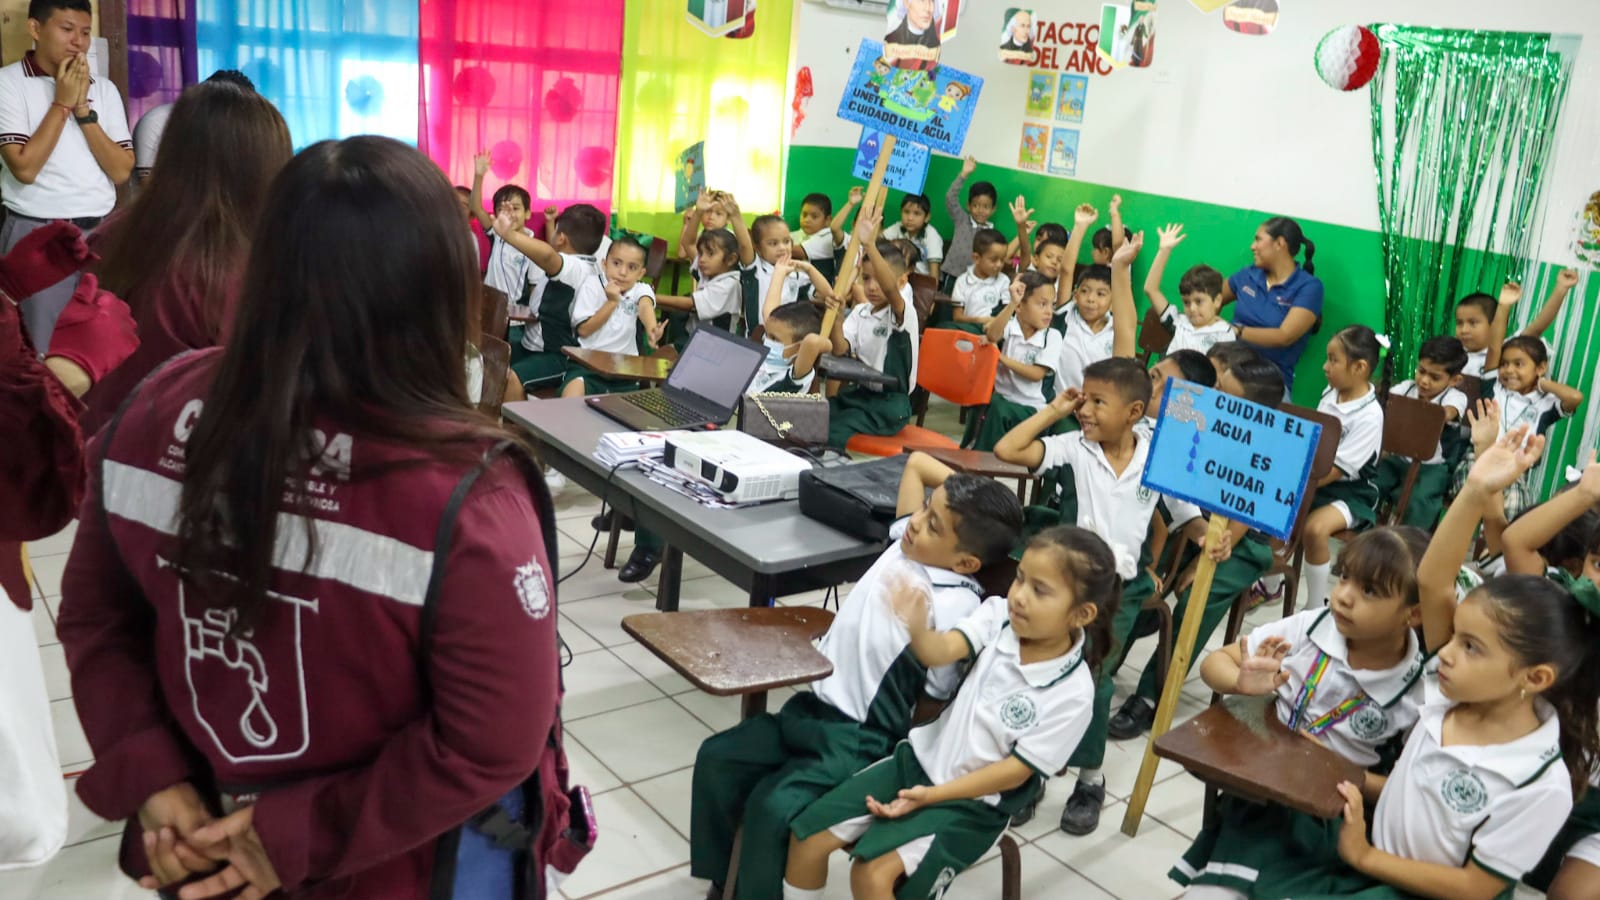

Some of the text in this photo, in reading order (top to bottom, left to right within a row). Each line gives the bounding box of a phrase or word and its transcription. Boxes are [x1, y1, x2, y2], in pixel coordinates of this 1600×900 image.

[848, 100, 951, 142] CUIDADO DEL AGUA
[853, 87, 944, 128] UNETE AL
[1211, 418, 1252, 446] AGUA
[1215, 394, 1305, 439] CUIDAR EL
[1250, 452, 1273, 472] ES
[1204, 459, 1296, 507] CUIDAR LA
[1220, 488, 1256, 517] VIDA
